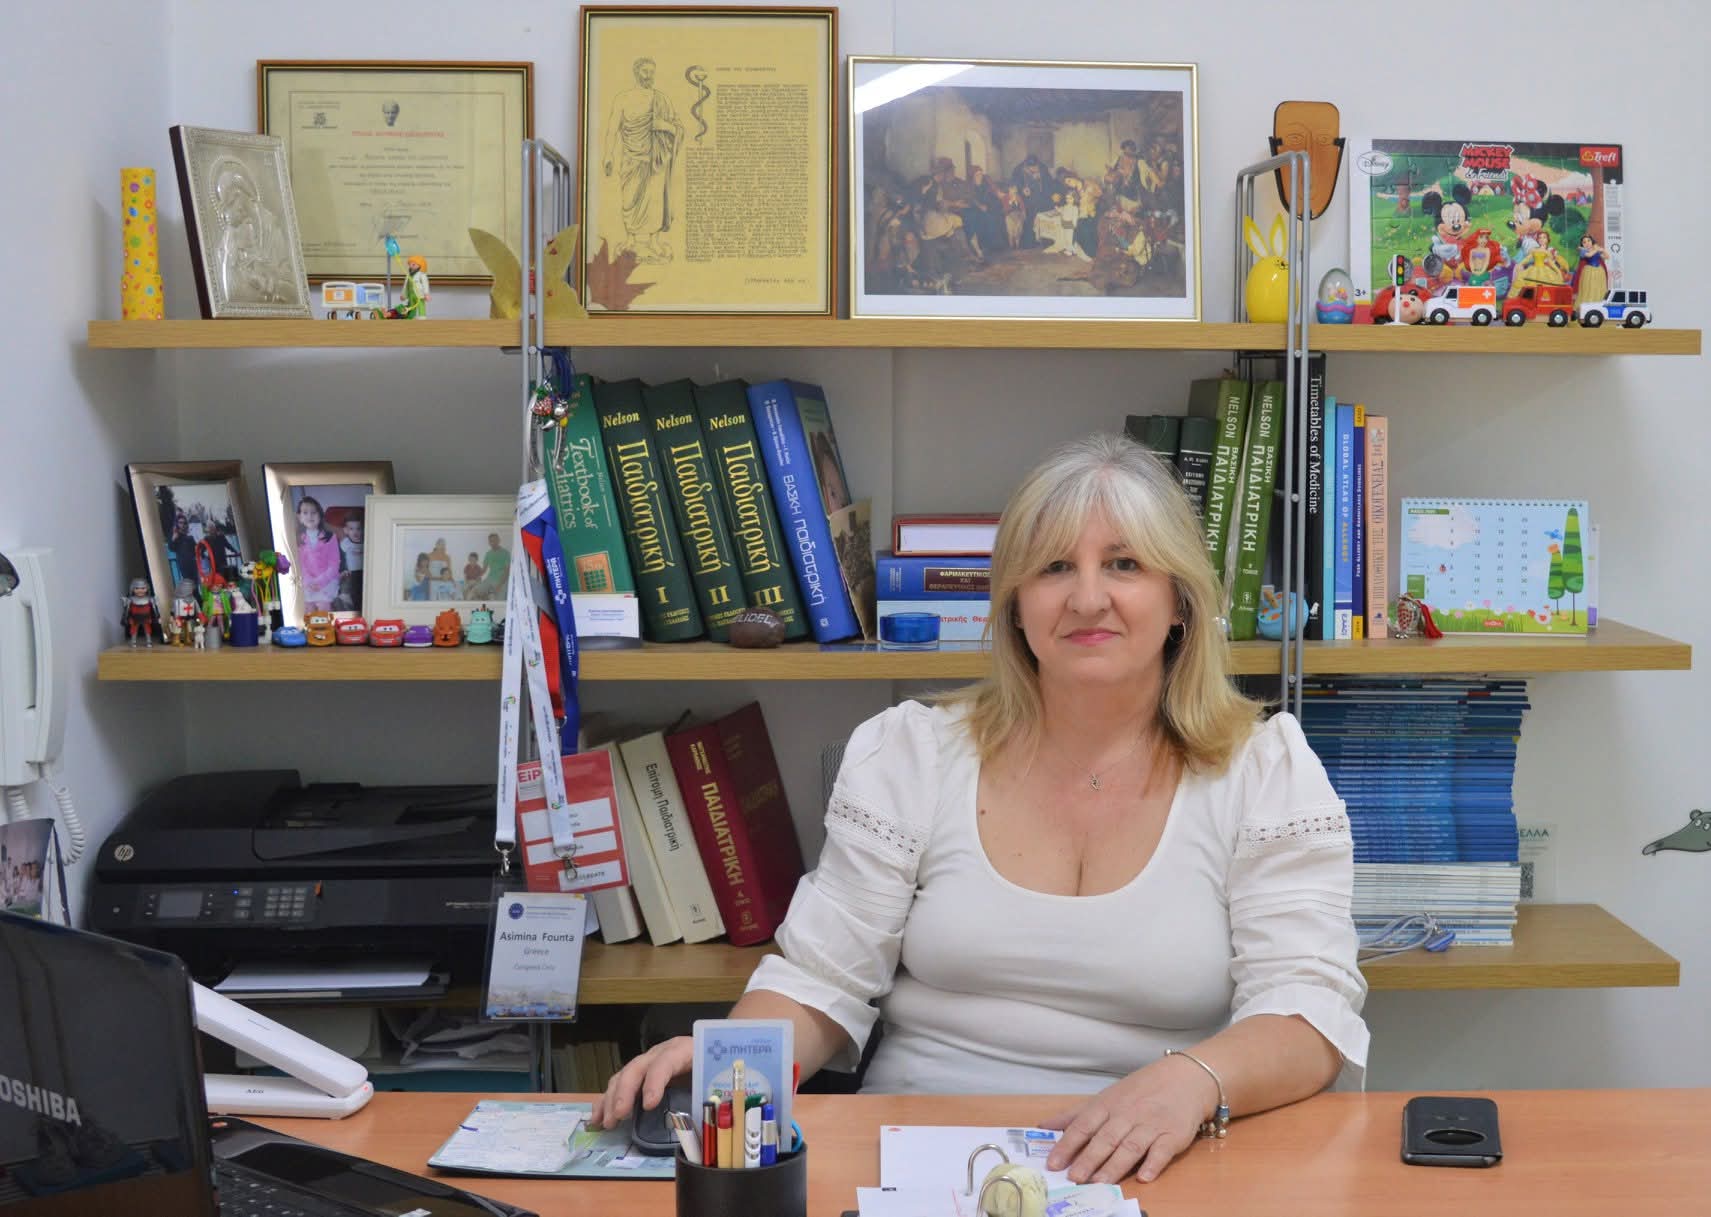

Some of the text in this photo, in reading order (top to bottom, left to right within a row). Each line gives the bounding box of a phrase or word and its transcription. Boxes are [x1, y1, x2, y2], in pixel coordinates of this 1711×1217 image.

[1462, 157, 1510, 169] MOUSE
[1594, 151, 1617, 163] Trefl
[1354, 289, 1366, 297] 3+
[603, 412, 640, 429] Nelson
[656, 414, 693, 431] Nelson
[709, 414, 745, 431] Nelson
[1225, 396, 1240, 438] NELSON
[1259, 395, 1273, 438] NELSON
[1309, 375, 1322, 514] Timetables of Medicine
[1342, 433, 1350, 470] GLOBAL
[1228, 447, 1239, 484] ΒΑΣΙΚΗ
[1264, 446, 1274, 483] ΒΑΣΙΚΗ
[569, 437, 599, 530] Textbook of
[1206, 445, 1230, 552] ΠΑΙΔΙΑΤΡΙΚΗ
[1242, 445, 1265, 552] ΠΑΙΔΙΑΤΡΙΚΗ
[1342, 474, 1350, 503] ATLAS
[617, 438, 676, 574] Παιδιατρική
[671, 440, 731, 575] Παιδιατρική
[723, 440, 780, 575] Παιδιατρική
[1342, 506, 1350, 518] OF
[708, 585, 731, 605] II
[753, 585, 784, 607] III
[114, 844, 134, 862] hp
[701, 782, 744, 887] ΠΑΙΔΙΑΤΡΙΚΗ
[500, 931, 575, 942] Asimina Founta
[0, 1074, 82, 1127] OSHIBA
